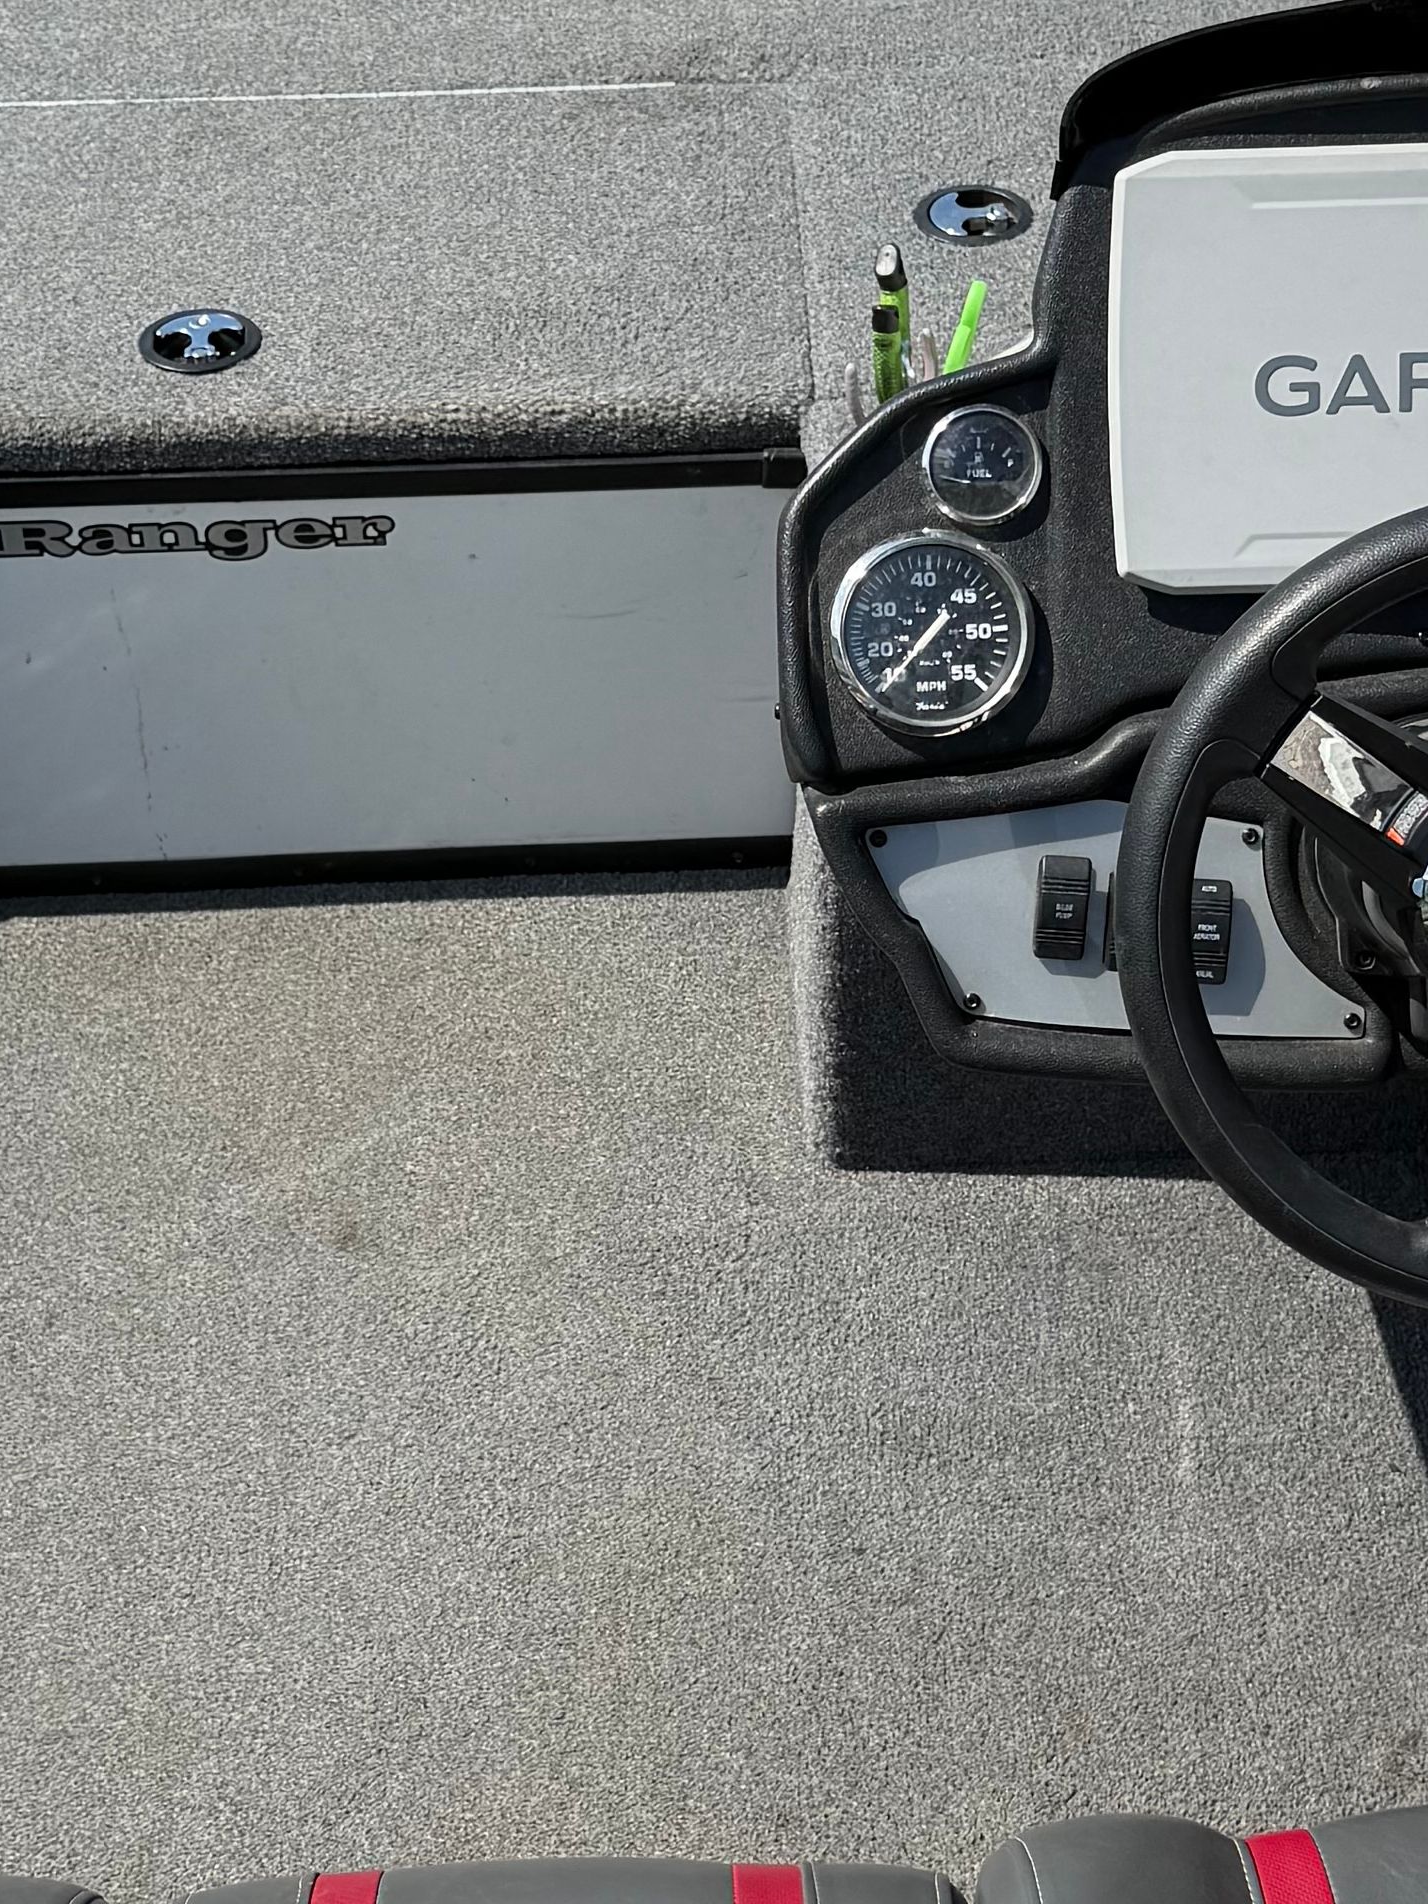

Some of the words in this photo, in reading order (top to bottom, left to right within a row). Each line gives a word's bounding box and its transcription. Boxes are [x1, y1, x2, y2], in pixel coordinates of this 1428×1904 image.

[910, 571, 937, 587] 40
[950, 587, 977, 605] 45
[871, 602, 897, 617] 30
[965, 623, 992, 640] 50
[867, 641, 893, 657] 20
[950, 664, 977, 681] 55
[915, 680, 947, 692] MPH
